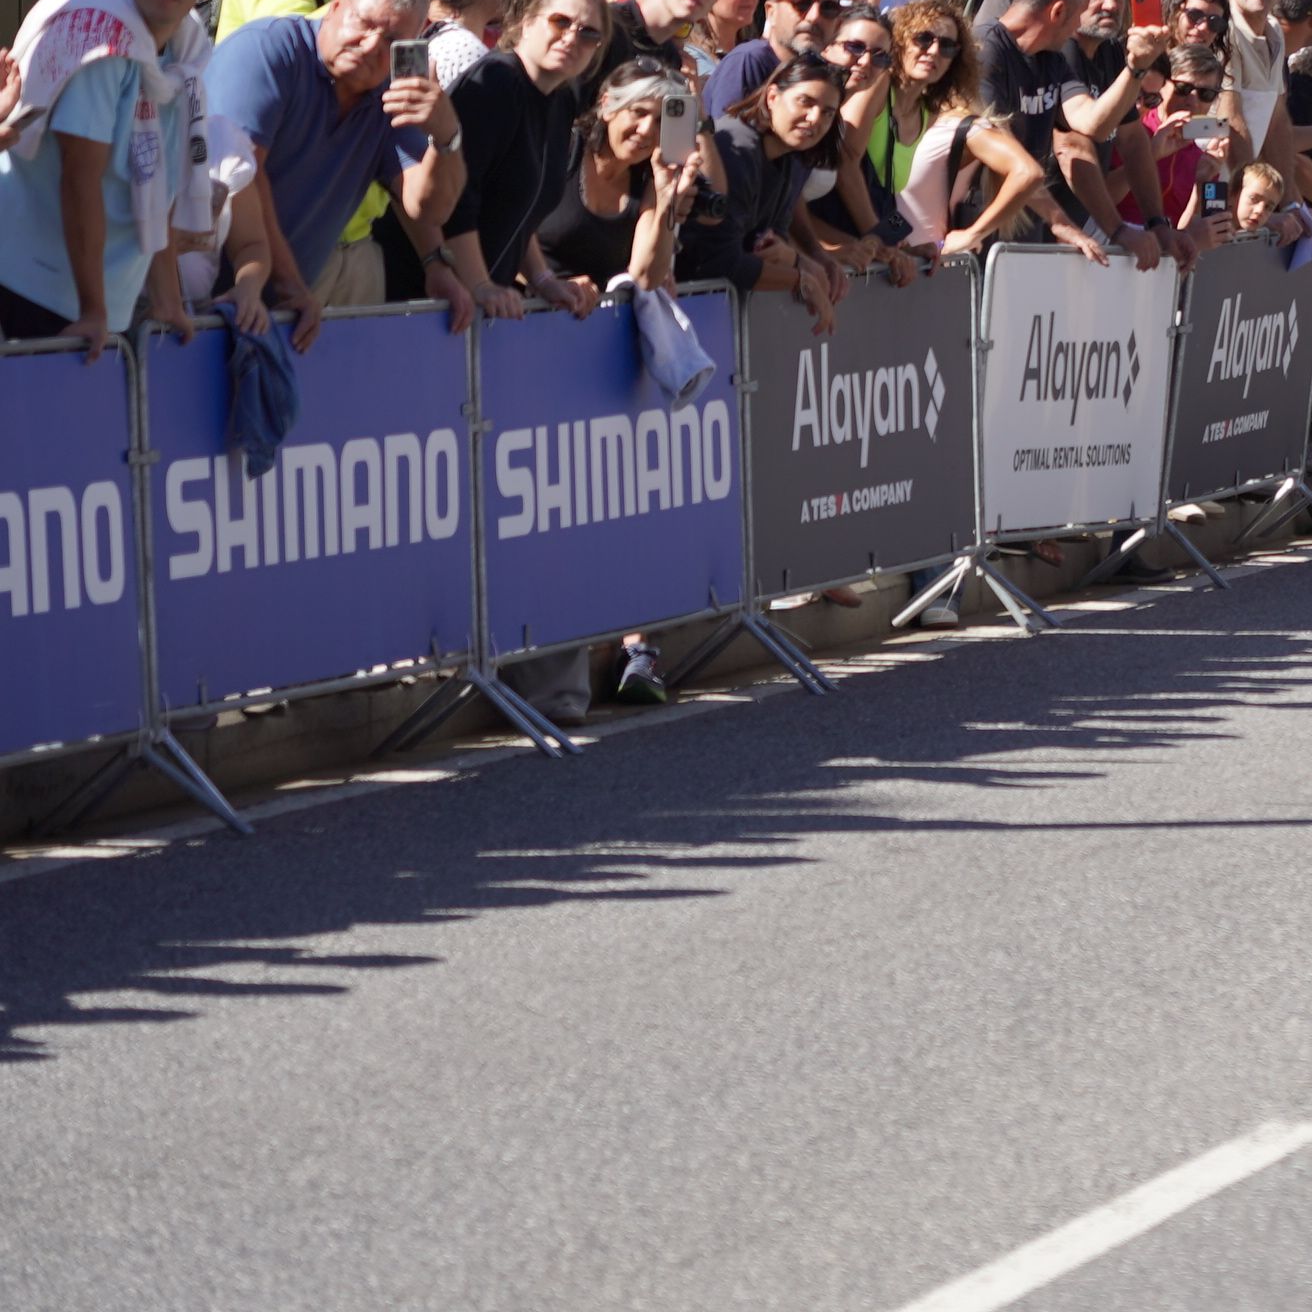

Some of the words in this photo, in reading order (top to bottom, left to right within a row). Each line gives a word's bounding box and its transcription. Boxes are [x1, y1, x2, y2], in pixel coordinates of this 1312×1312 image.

[1019, 311, 1121, 426] Alayan
[1206, 293, 1285, 399] Alayan
[792, 342, 921, 468] Alayan
[1013, 448, 1050, 472] OPTIMAL
[1053, 446, 1084, 468] RENTAL
[1086, 443, 1132, 466] SOLUTIONS
[1232, 410, 1270, 436] COMPANY
[165, 428, 460, 581] SHIMANO
[495, 399, 732, 540] SHIMANO
[852, 479, 914, 512] COMPANY
